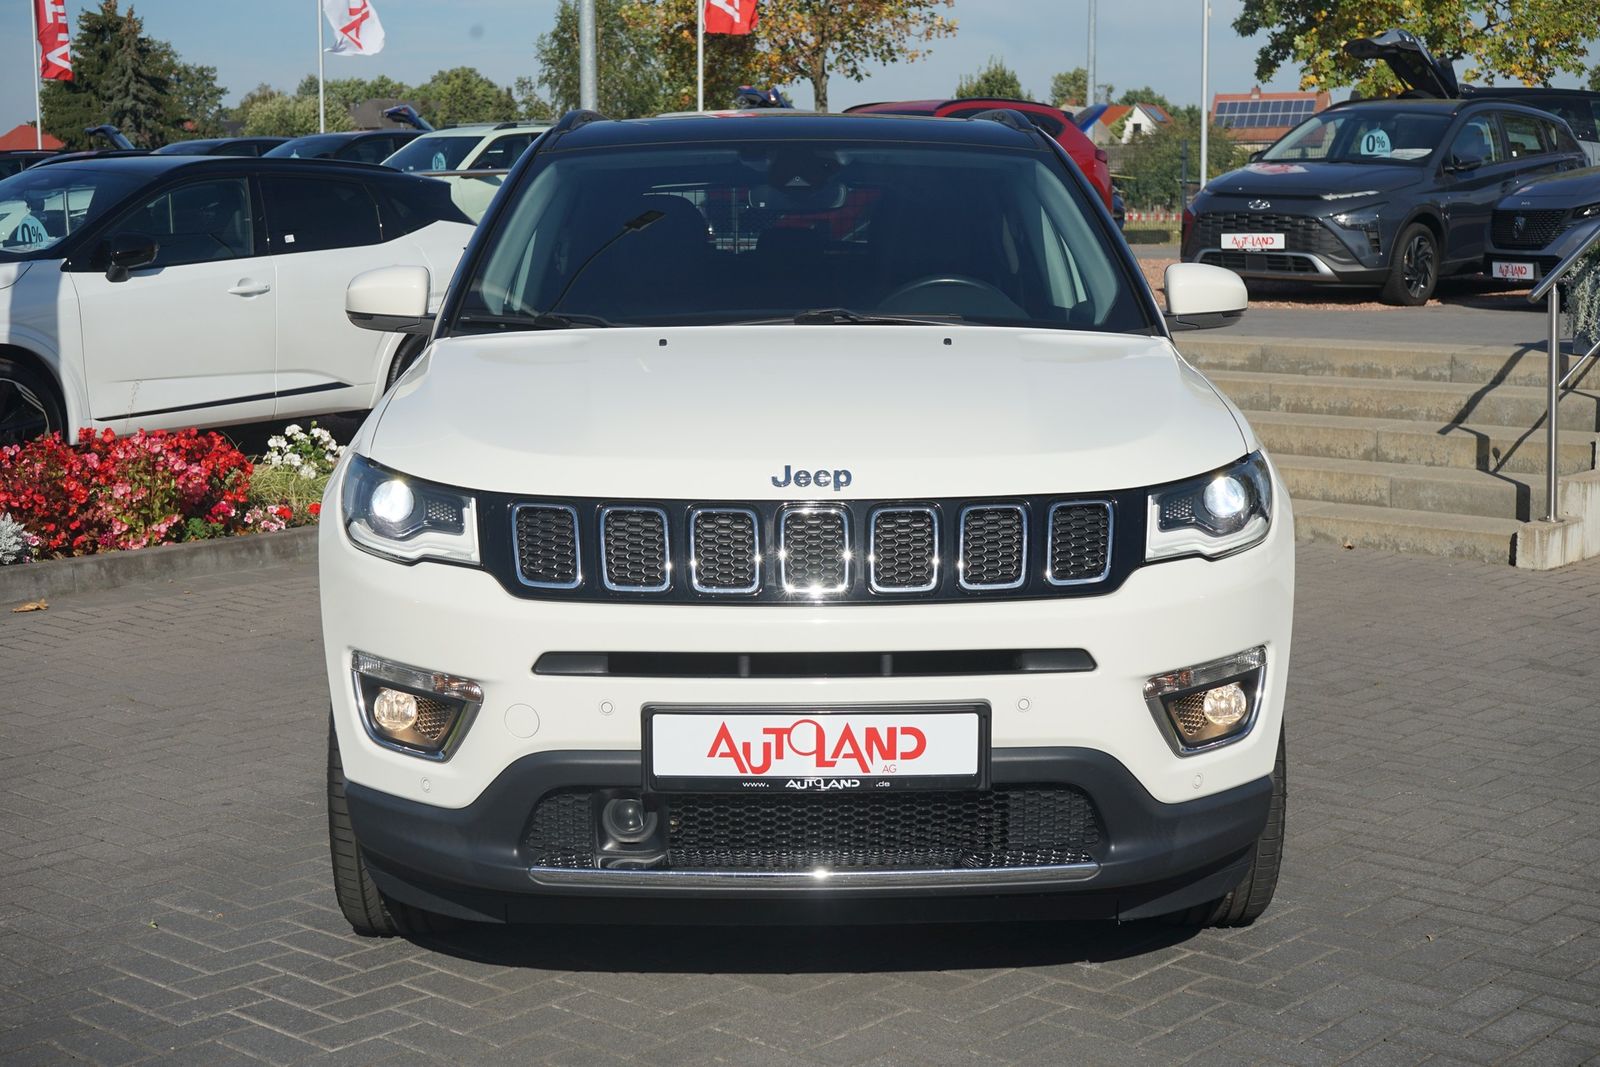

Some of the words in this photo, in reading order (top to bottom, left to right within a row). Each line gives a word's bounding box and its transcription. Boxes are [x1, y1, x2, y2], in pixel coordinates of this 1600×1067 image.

[1366, 134, 1386, 153] 0%
[771, 464, 852, 491] Jeep
[881, 763, 897, 774] AG
